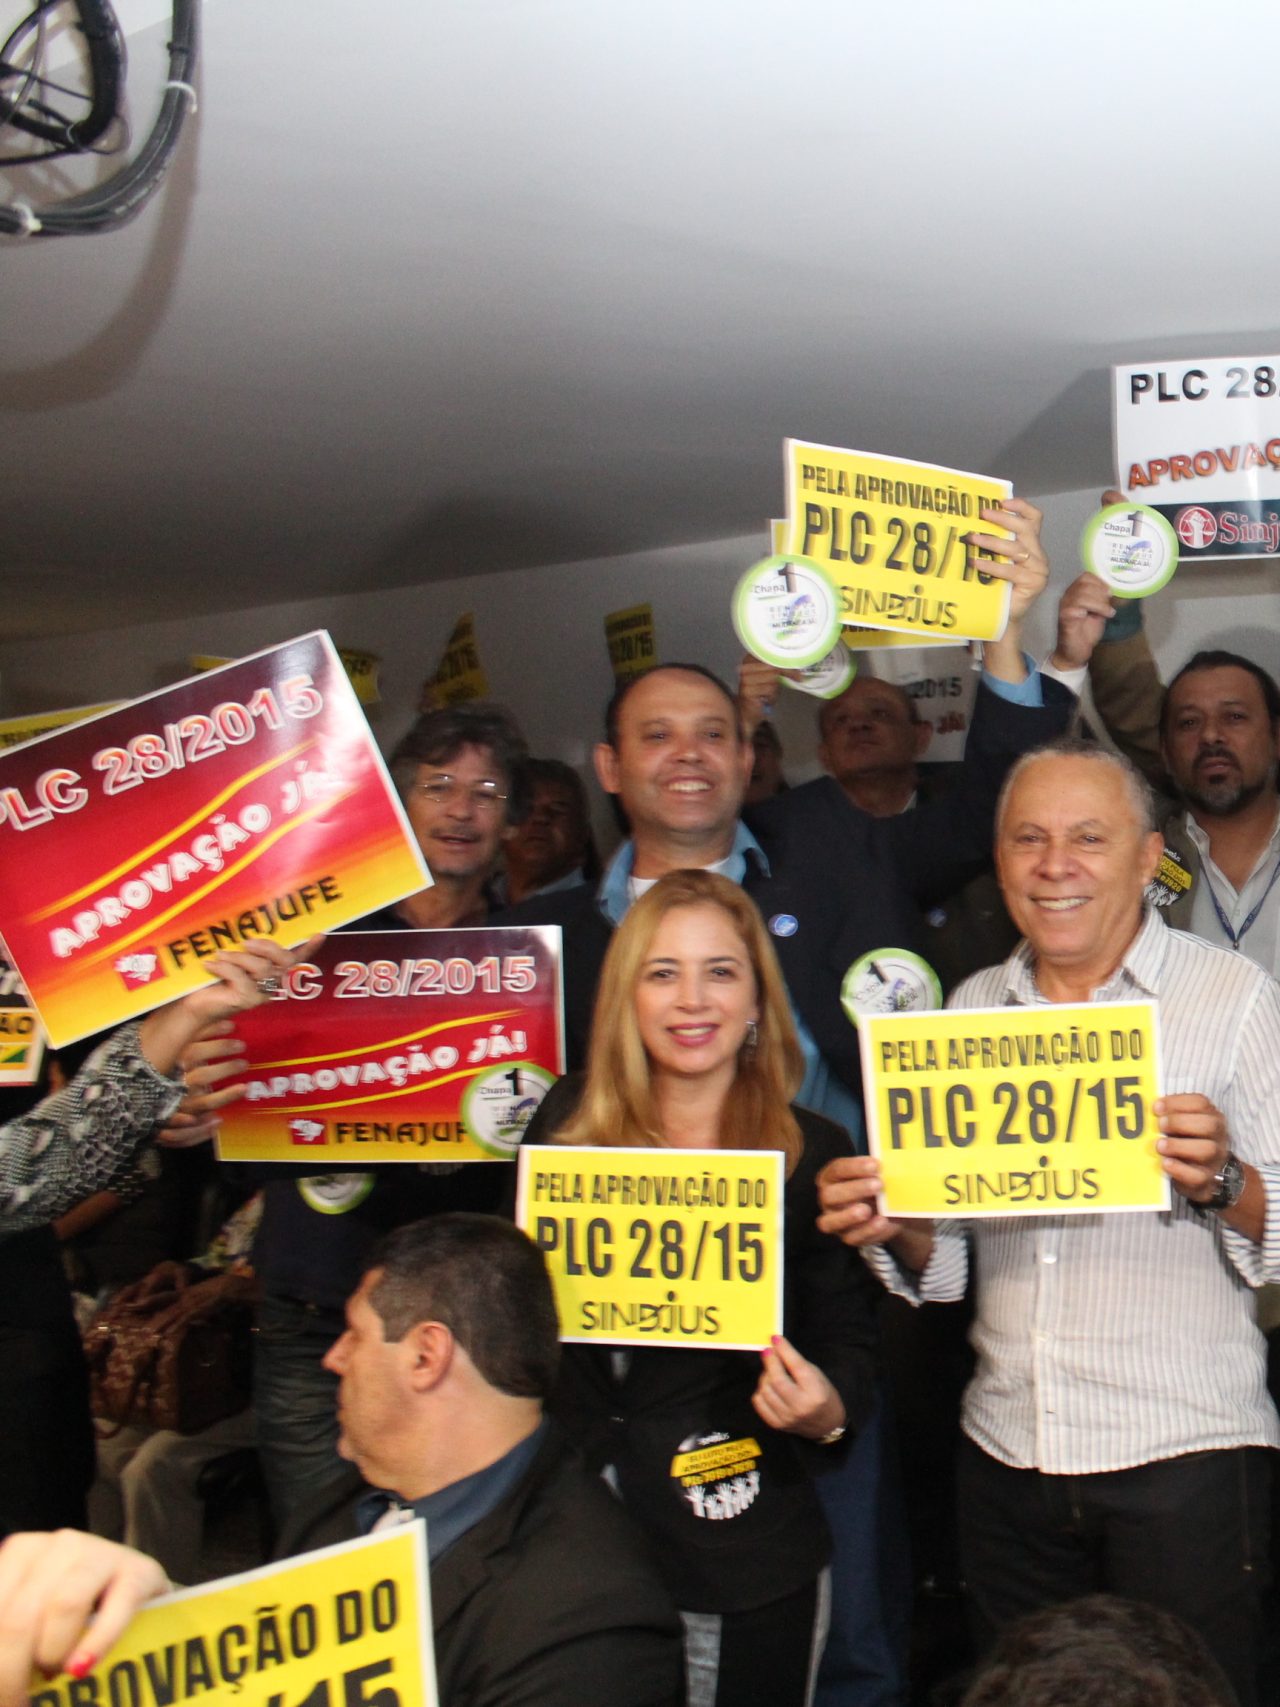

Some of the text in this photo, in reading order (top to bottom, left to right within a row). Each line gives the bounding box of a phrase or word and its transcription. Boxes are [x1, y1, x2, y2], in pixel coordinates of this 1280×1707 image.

[1129, 368, 1209, 405] PLC
[801, 464, 850, 497] PELA
[854, 474, 971, 519] APROVAÇÃO
[801, 502, 874, 566] PLC
[1104, 510, 1144, 536] Chapa 1
[777, 562, 797, 593] 1
[92, 675, 324, 796] 28/2015
[48, 803, 272, 958] APROVAÇÃO
[168, 875, 343, 968] FENAJUFE
[333, 956, 537, 998] 28/2015
[245, 1024, 528, 1100] APROVAÇÃO JÁ!
[881, 1026, 1144, 1072] PELA APROVAÇÃO DO
[504, 1068, 523, 1096] 1
[334, 1121, 468, 1146] FENAJUF
[887, 1076, 1145, 1150] PLC 28/15
[536, 1171, 767, 1213] PELA APROVAÇÃO DO
[536, 1216, 766, 1282] PLC 28/15
[335, 1579, 399, 1645] DO
